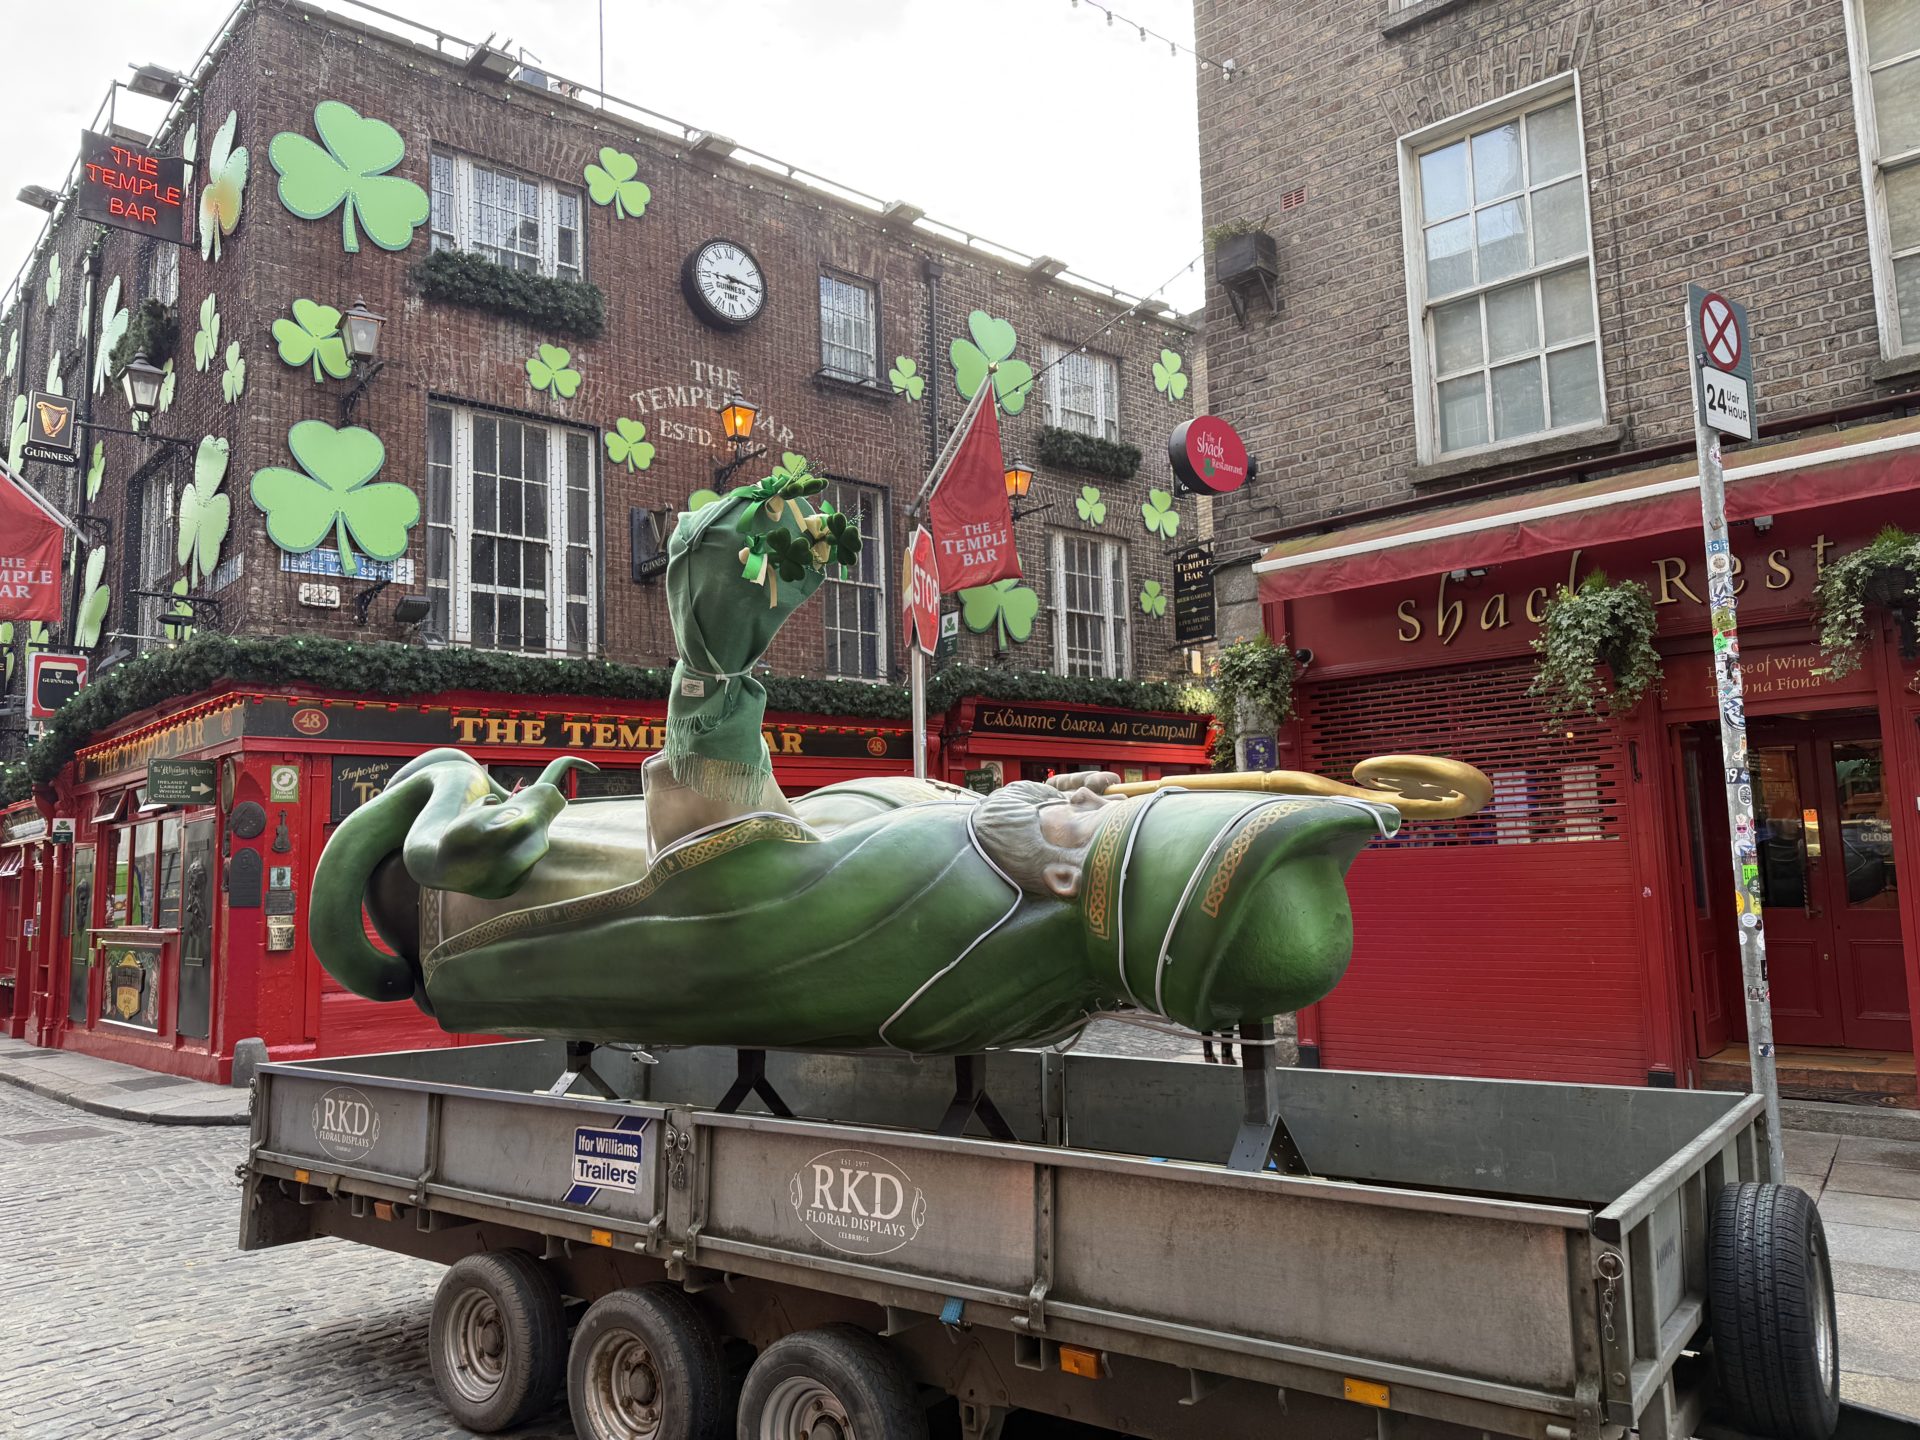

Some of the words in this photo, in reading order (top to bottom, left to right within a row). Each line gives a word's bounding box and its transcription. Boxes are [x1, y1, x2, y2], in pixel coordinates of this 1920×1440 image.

[111, 146, 158, 176] THE
[86, 163, 180, 206] TEMPLE
[110, 197, 157, 225] BAR
[715, 281, 746, 296] GUINNESS
[724, 292, 738, 301] TIME
[690, 360, 740, 390] THE
[1706, 384, 1727, 414] 24
[1726, 391, 1740, 404] Uair
[1728, 406, 1747, 422] HOUR
[24, 446, 75, 463] GUINNESS
[1197, 431, 1225, 463] Shack
[962, 522, 991, 537] THE
[941, 529, 1008, 555] TEMPLE
[285, 554, 326, 571] TEMPLE
[360, 567, 393, 580] SOUTH
[962, 548, 998, 567] BAR
[1176, 558, 1212, 573] TEMPLE
[1187, 553, 1199, 561] THE
[1184, 570, 1204, 582] BAR
[913, 563, 938, 616] STOP
[1756, 654, 1770, 676] of
[1774, 654, 1816, 671] Wine
[1753, 681, 1772, 694] na
[299, 713, 321, 729] 48
[453, 717, 547, 747] THE
[176, 715, 204, 753] BAR
[870, 741, 882, 752] 48
[338, 763, 389, 782] Importers
[322, 1098, 370, 1136] RKD
[319, 1129, 341, 1143] FLORAL
[341, 1134, 370, 1148] DISPLAYS
[578, 1135, 594, 1152] Ifor
[596, 1137, 638, 1158] Williams
[578, 1159, 637, 1185] Trailers
[855, 1160, 870, 1168] 1977
[811, 1164, 904, 1220] RKD
[806, 1209, 848, 1228] FLORAL
[851, 1216, 906, 1238] DISPLAYS
[838, 1231, 870, 1242] CELBRIDGE
